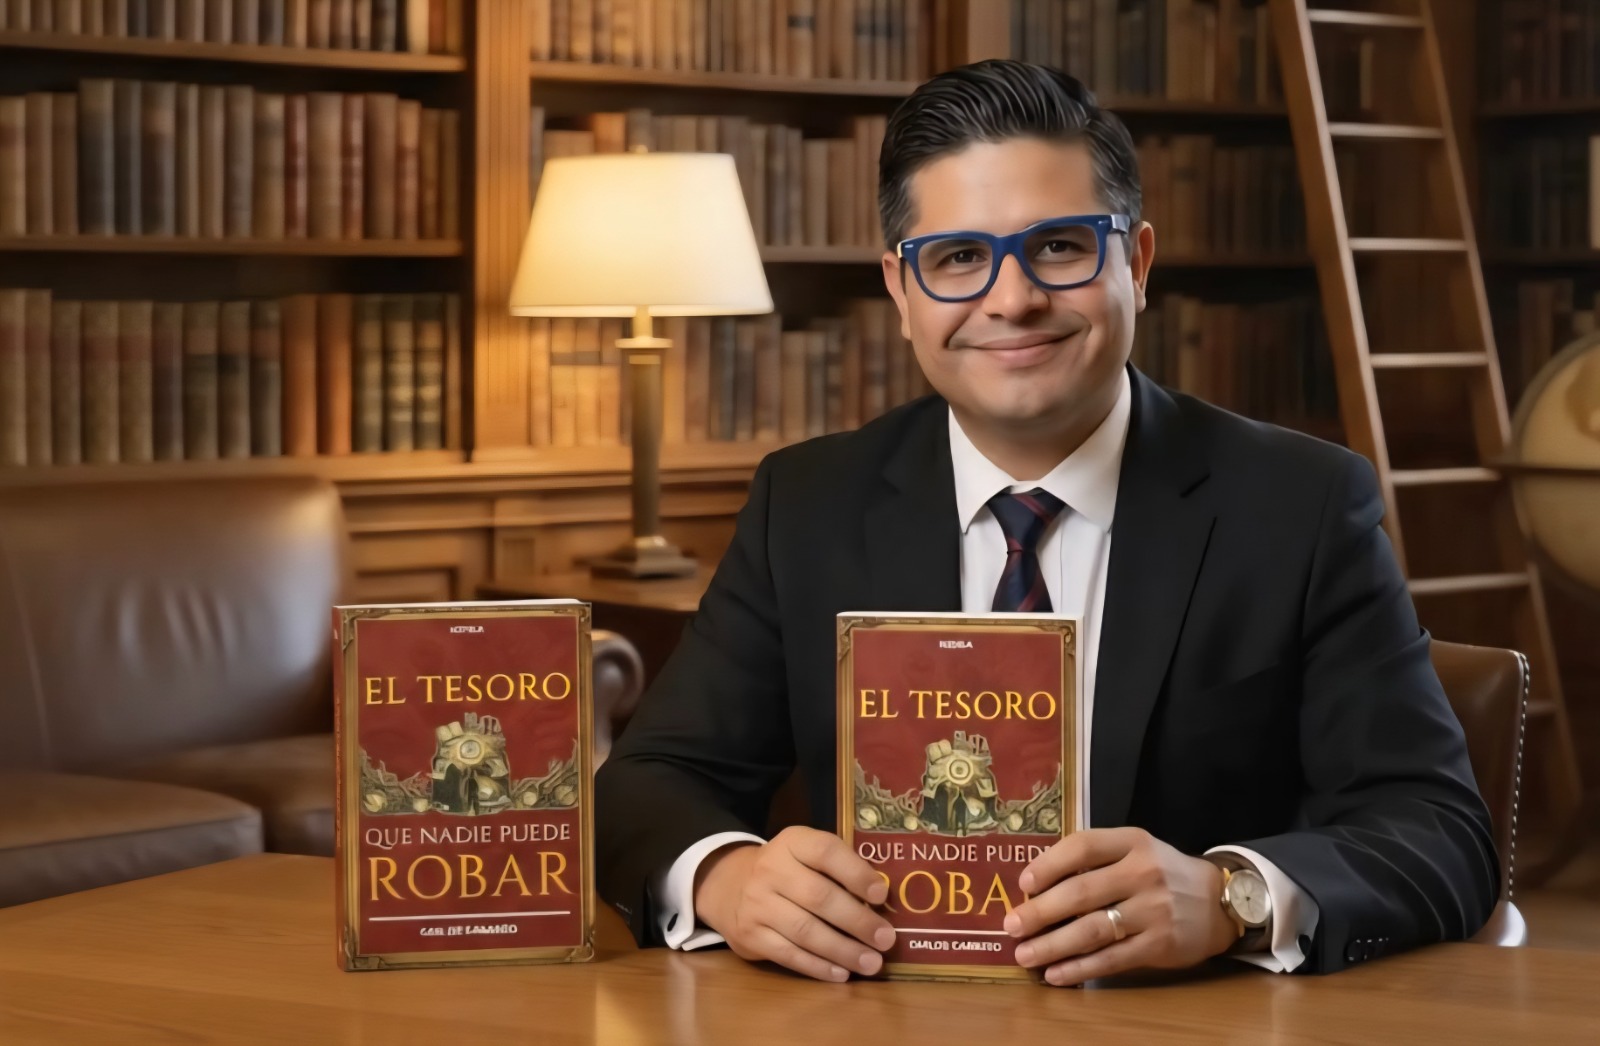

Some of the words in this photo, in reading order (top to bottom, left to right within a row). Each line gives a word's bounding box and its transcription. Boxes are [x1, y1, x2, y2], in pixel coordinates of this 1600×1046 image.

[365, 675, 406, 705] EL
[416, 671, 572, 704] TESORO
[859, 689, 899, 719] EL
[908, 690, 1057, 721] TESORO
[365, 826, 413, 850] QUE
[420, 825, 492, 845] NADIE
[499, 823, 571, 843] PUEDE
[858, 841, 905, 864] QUE
[911, 842, 978, 863] NADIE
[985, 844, 1053, 864] PUED
[368, 851, 575, 902] ROBAR
[866, 869, 1030, 917] OBA
